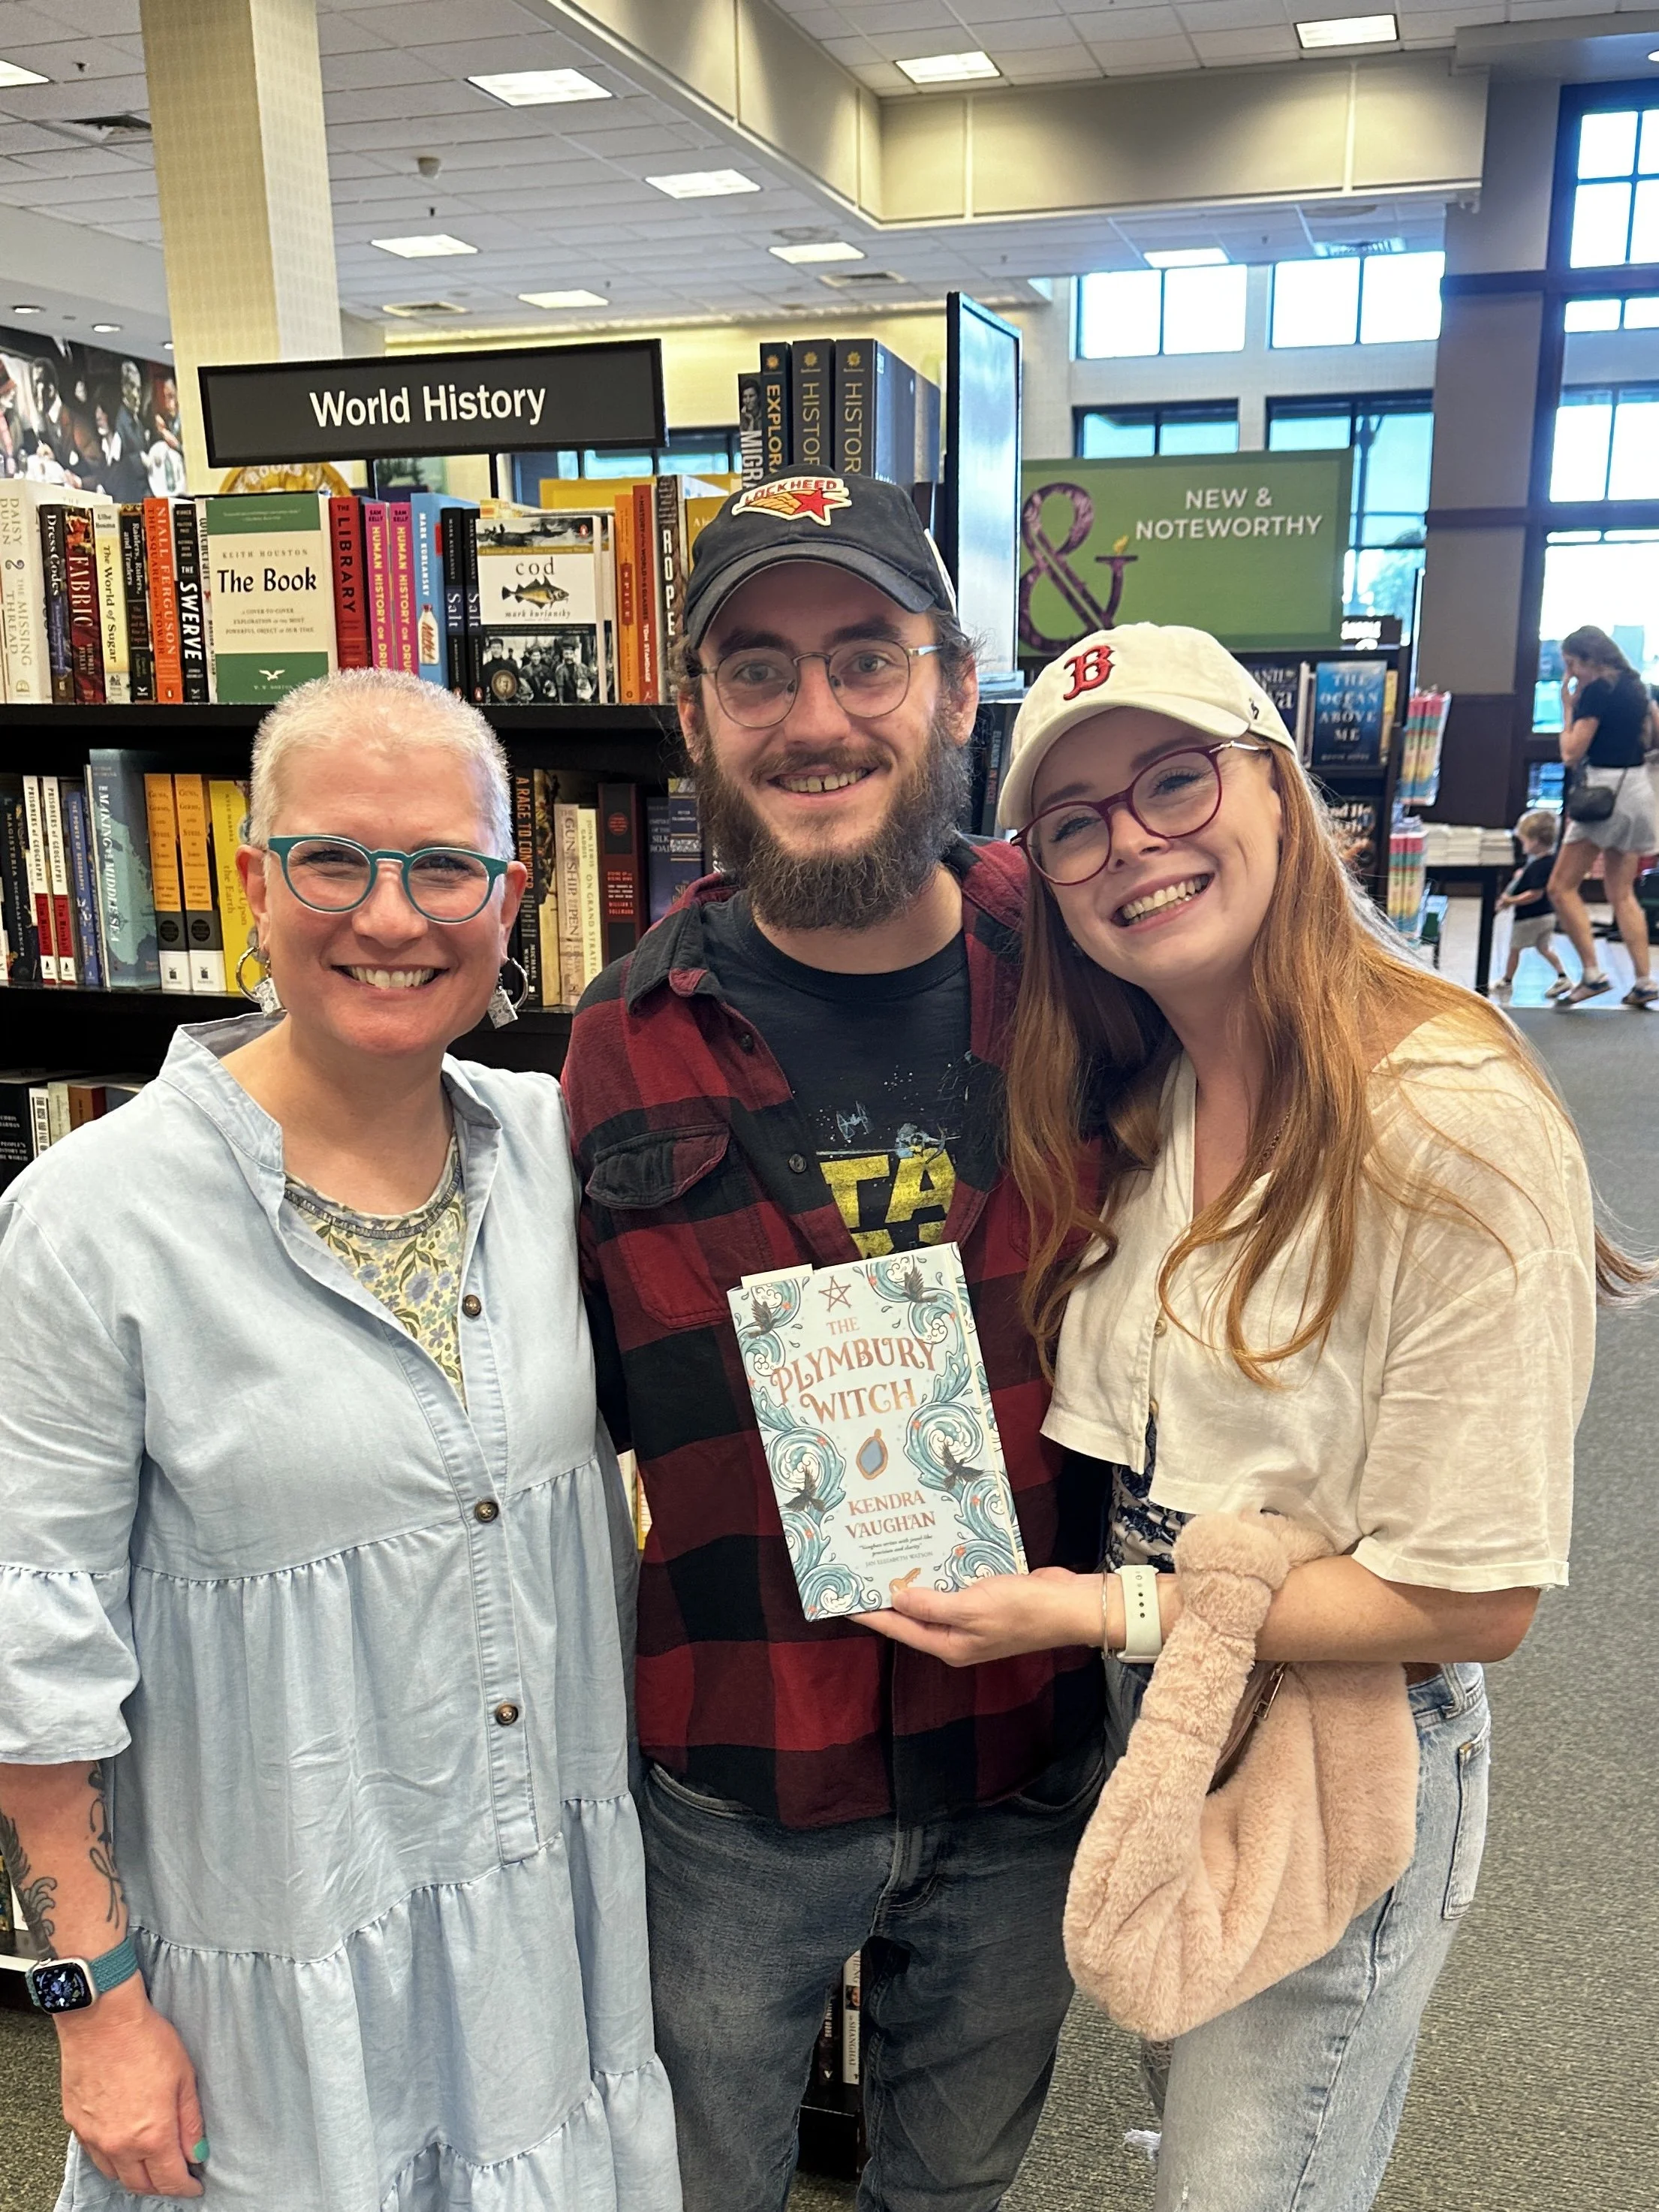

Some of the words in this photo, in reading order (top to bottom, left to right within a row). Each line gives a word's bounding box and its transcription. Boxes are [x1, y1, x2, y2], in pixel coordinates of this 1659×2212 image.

[309, 387, 411, 427] World
[423, 384, 546, 426] History
[766, 384, 782, 474] EXPLOR
[845, 382, 863, 473] HISTOR
[745, 479, 838, 505] LOCKHEED
[1185, 487, 1248, 510] NEW
[1256, 486, 1273, 508] &
[0, 498, 11, 545] DUNN
[10, 498, 23, 546] DAISY
[47, 514, 57, 553] Dress
[147, 508, 156, 529] THE
[156, 507, 170, 558] NIALL
[419, 512, 427, 539] MARK
[1135, 515, 1323, 541] NOTEWORTHY
[103, 545, 112, 565] The
[149, 535, 160, 583] SQUARE
[222, 550, 254, 559] KEITH
[260, 549, 309, 559] HOUSTON
[338, 517, 357, 613] LIBRARY
[372, 526, 383, 569] HUMAN
[396, 526, 408, 570] HUMAN
[515, 556, 555, 576] cod
[50, 553, 62, 596] Codes
[104, 567, 115, 606] World
[181, 565, 194, 574] THE
[217, 568, 254, 593] The
[264, 566, 317, 592] Book
[420, 542, 429, 597] KURLANSKY
[662, 529, 676, 636] ROPE
[68, 556, 93, 627] FABRIC
[161, 565, 176, 655] FERGUSON
[374, 573, 386, 624] HISTORY
[399, 574, 410, 625] HISTORY
[447, 592, 462, 628] Salt
[467, 592, 481, 628] Salt
[6, 591, 19, 655] THREAD
[17, 601, 32, 666] MISSING
[155, 611, 164, 655] TOWER
[180, 581, 203, 661] SWERVE
[504, 609, 527, 618] mark
[107, 623, 117, 663] Sugar
[378, 643, 387, 668] DRU
[1063, 645, 1116, 701] B
[1318, 711, 1377, 724] ABOVE
[1319, 691, 1380, 707] OCEAN
[1333, 728, 1361, 742] ME
[516, 776, 530, 785] A
[28, 786, 38, 827] PRISONERS
[47, 787, 58, 828] PRISONERS
[99, 793, 113, 848] MAKING
[516, 788, 531, 819] RAGE
[6, 812, 17, 876] MAGISTERIA
[518, 823, 532, 838] TO
[32, 839, 43, 881] GEOGRAPHY
[52, 840, 62, 883] GEOGRAPHY
[223, 865, 233, 883] the
[104, 860, 119, 915] MIDDLE
[225, 885, 235, 914] Earth
[586, 874, 594, 890] ON
[110, 917, 120, 942] SEA
[237, 897, 248, 926] Upon
[586, 892, 596, 928] GRAND
[588, 931, 598, 975] STRATEG
[819, 1147, 956, 1229] TA
[826, 1316, 860, 1336] THE
[769, 1337, 936, 1405] PLYMBURY
[799, 1378, 917, 1425] WITCH
[847, 1490, 926, 1517] KENDRA
[845, 1511, 937, 1539] VAUGHAN
[848, 2021, 857, 2067] SHANGHAI
